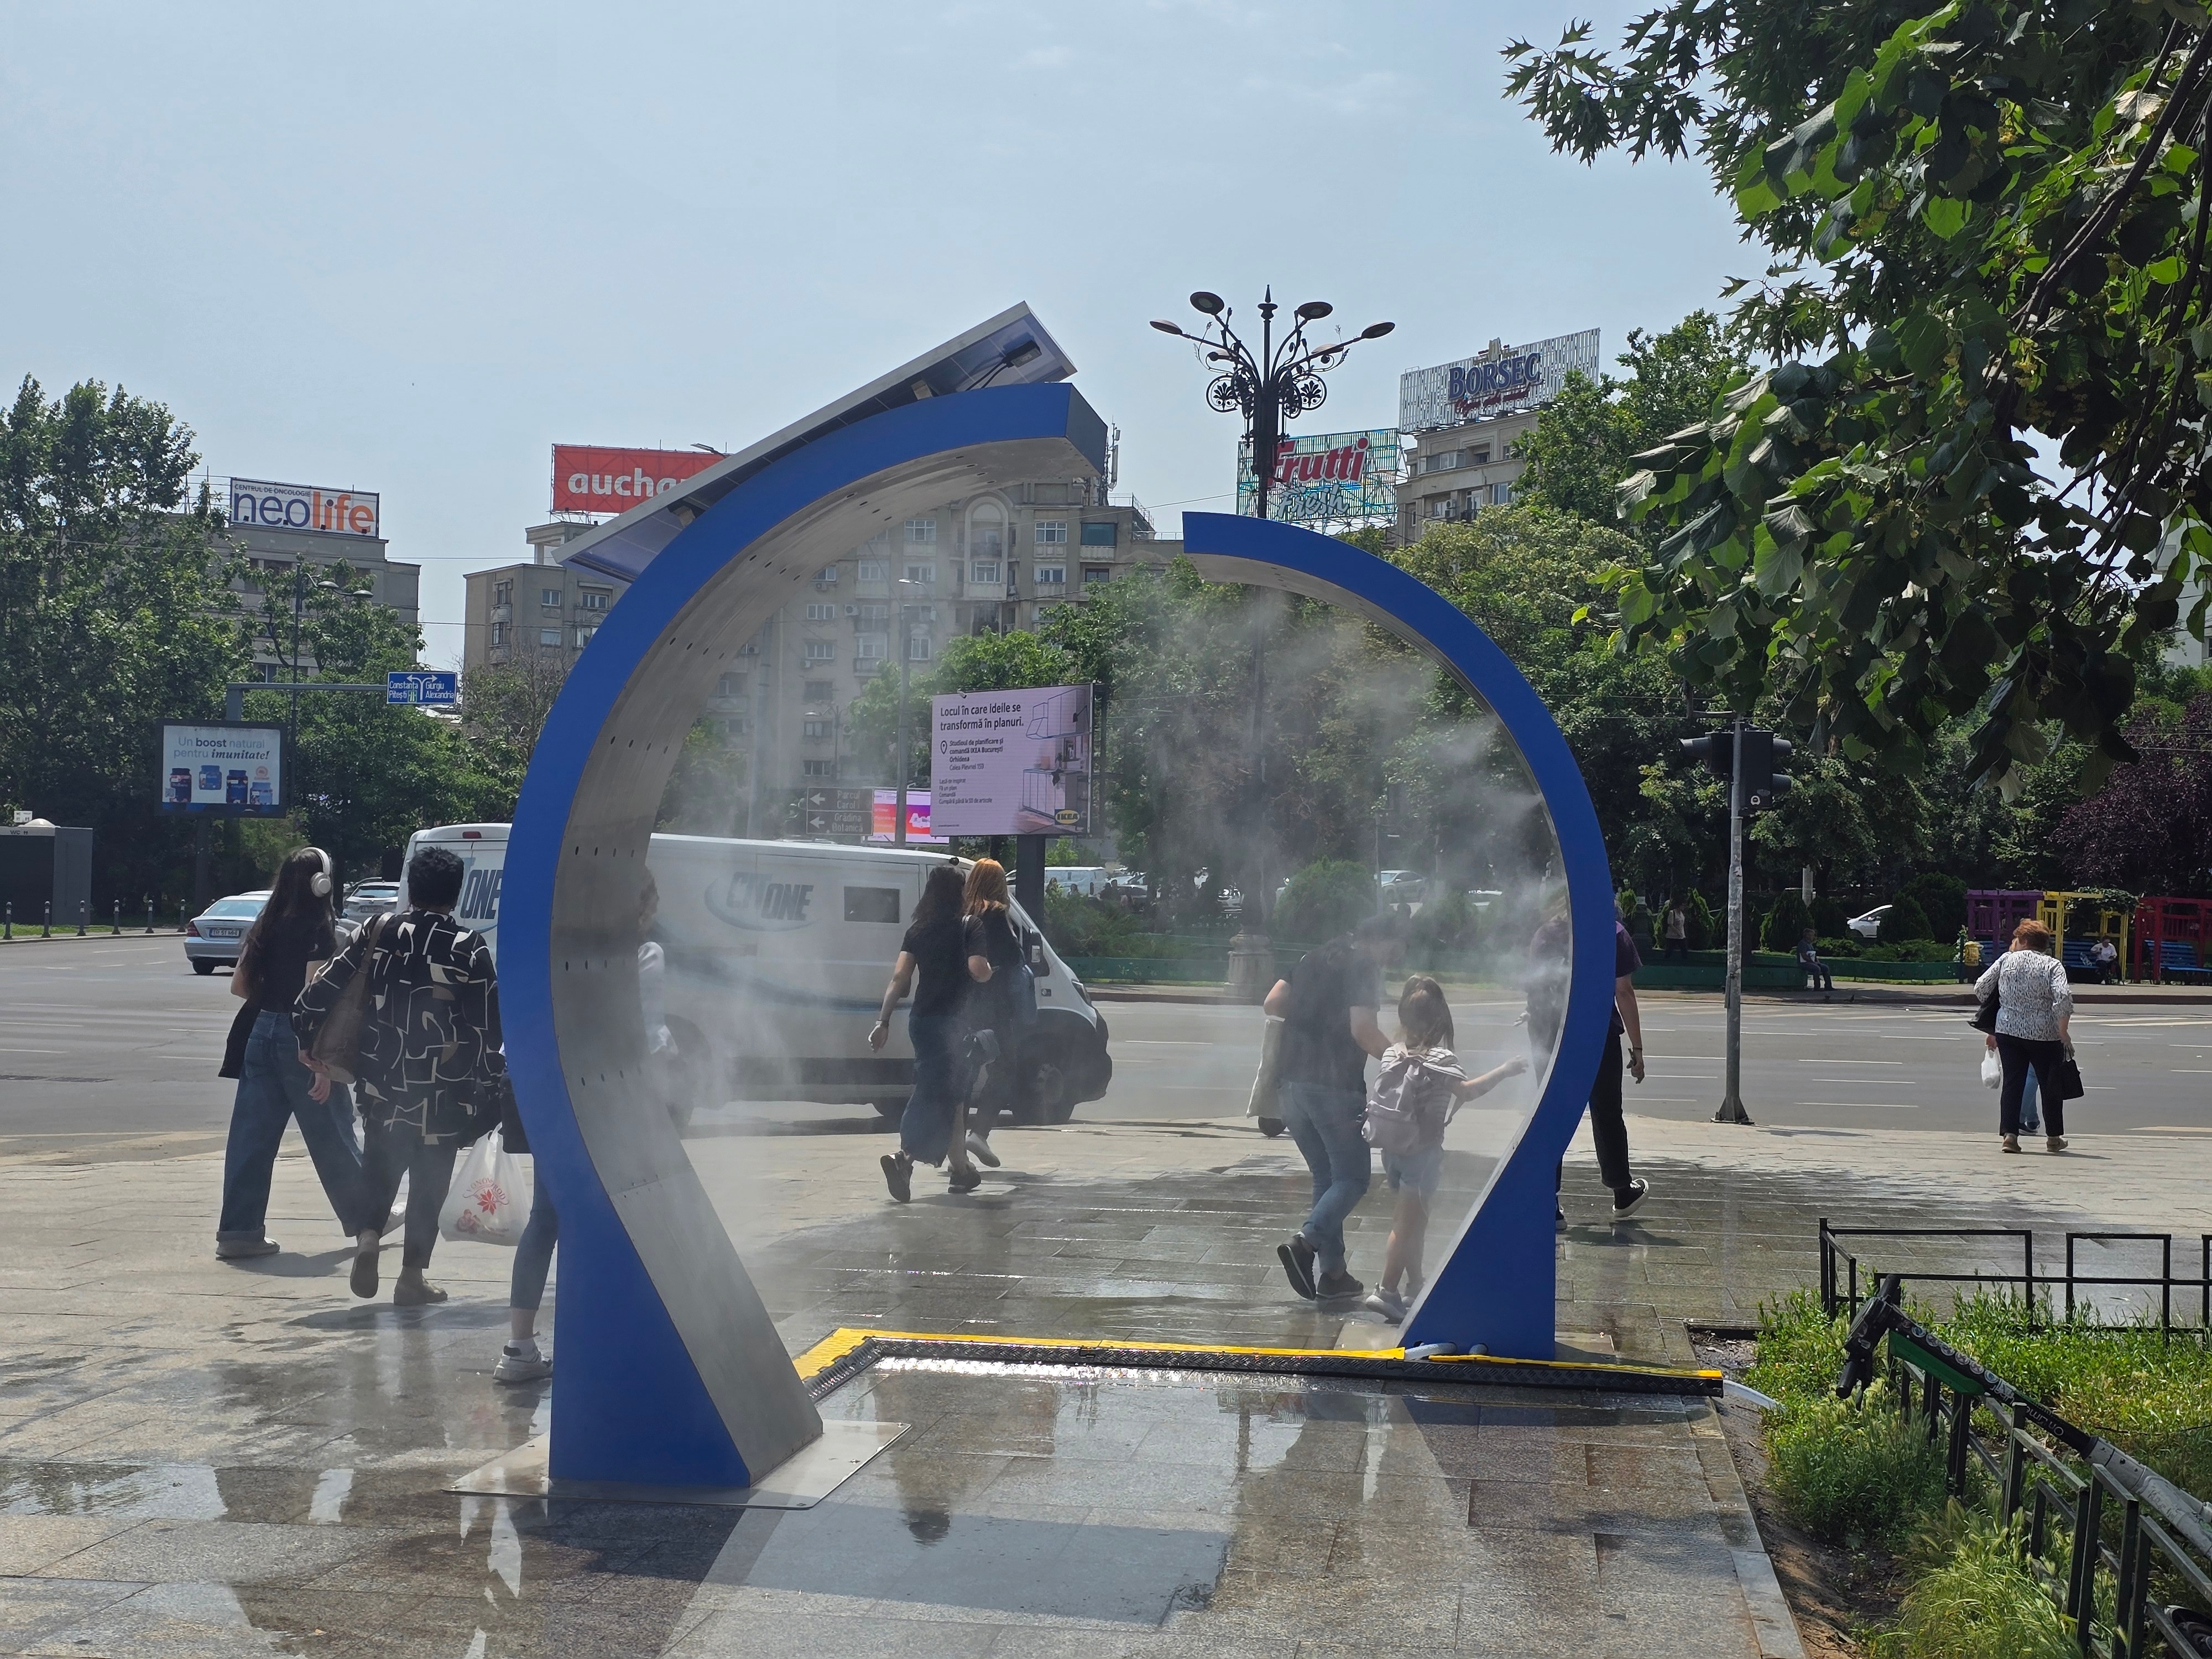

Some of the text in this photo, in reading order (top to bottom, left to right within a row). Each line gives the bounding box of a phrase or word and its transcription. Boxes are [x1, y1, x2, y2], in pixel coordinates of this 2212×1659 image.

[1448, 352, 1541, 400] BORSEC
[1267, 436, 1370, 489] Frutti
[568, 468, 691, 497] aucha
[234, 484, 263, 492] CENTRUL
[274, 488, 311, 497] ONCOLOGIE
[1277, 484, 1349, 518] Fresh
[233, 491, 374, 533] neolife
[425, 681, 445, 691] Giurgiu
[425, 690, 454, 698] Alexandria
[941, 702, 1021, 717] Locul în care ideile se
[940, 716, 1024, 731] transformă în planuri.
[178, 736, 265, 749] Un boost natural
[174, 749, 270, 760] pentru imunitate!
[837, 790, 860, 799] Parcul
[837, 800, 855, 809] Carol
[834, 813, 862, 822] Grădina
[460, 869, 503, 919] ONE
[760, 883, 814, 921] ONE
[2048, 1421, 2064, 1436] On
